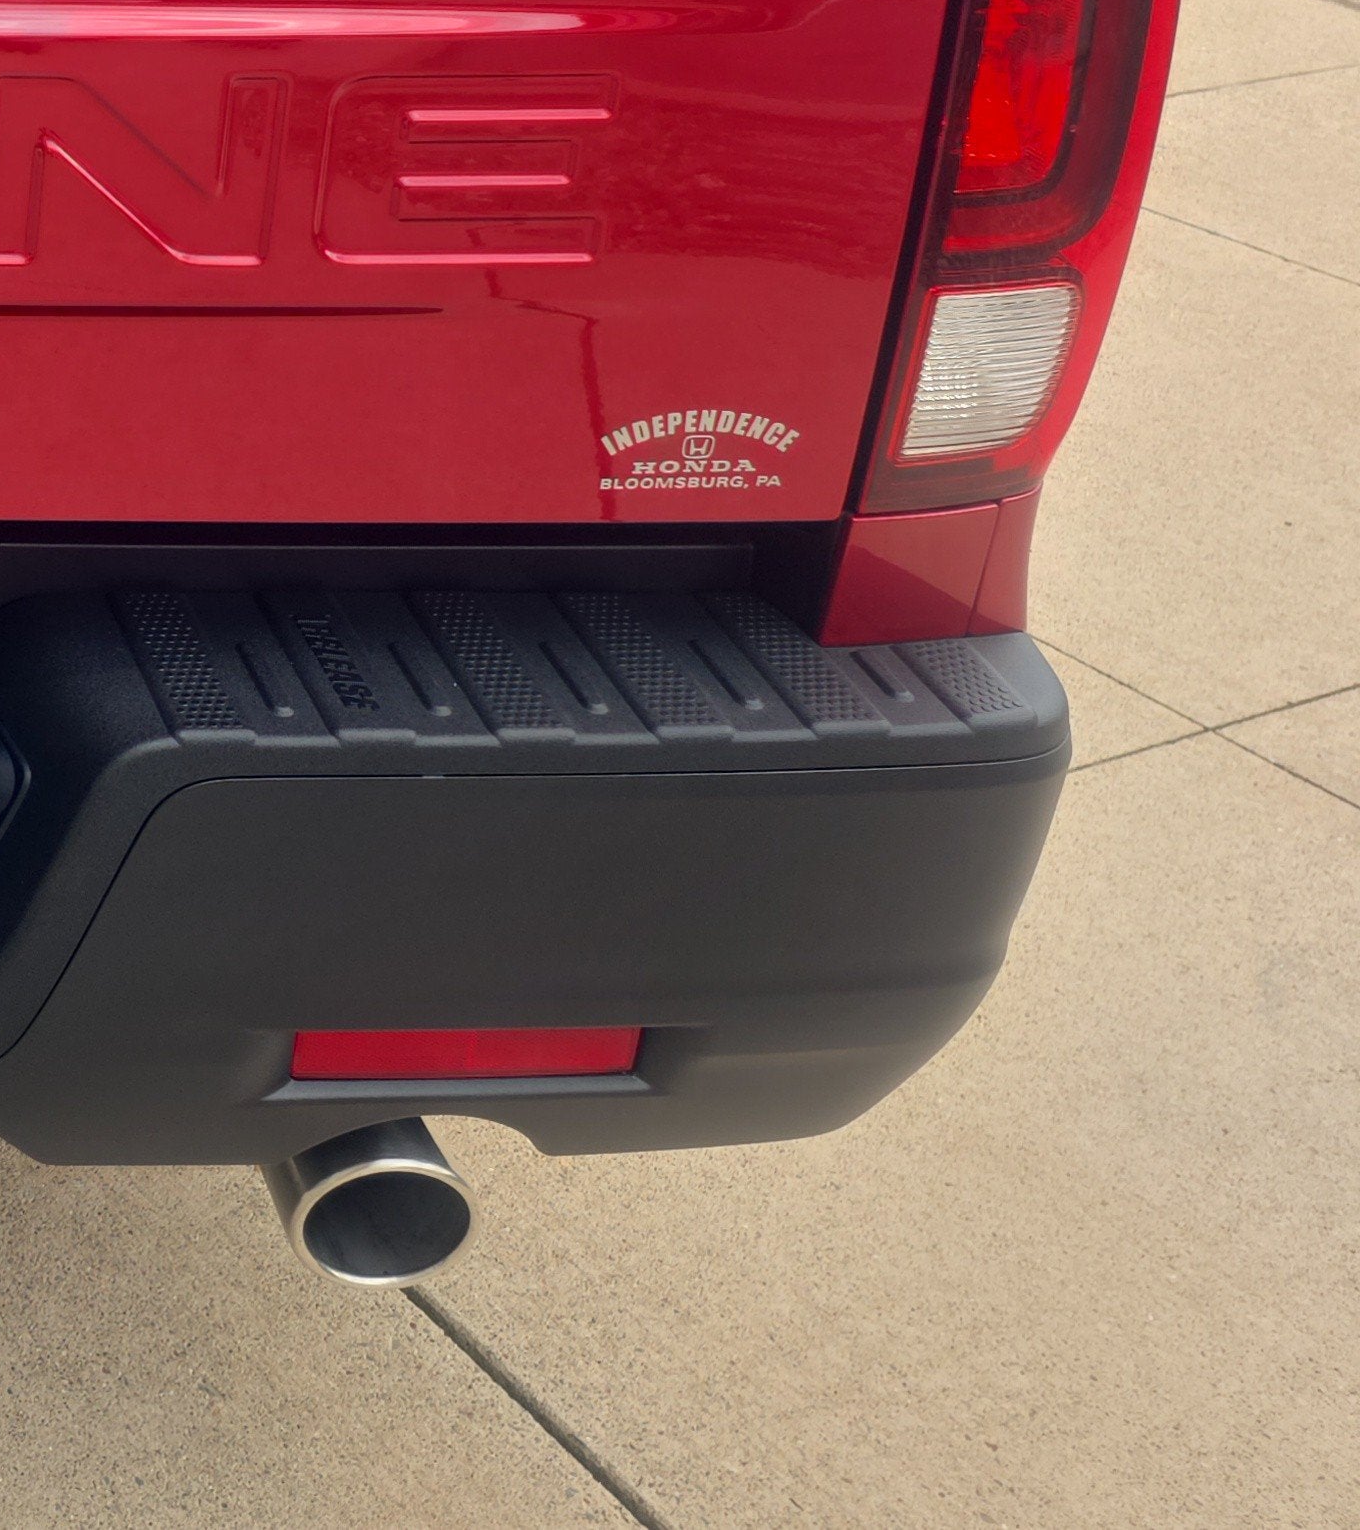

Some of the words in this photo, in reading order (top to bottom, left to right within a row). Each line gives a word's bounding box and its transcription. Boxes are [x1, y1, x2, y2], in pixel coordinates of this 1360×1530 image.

[600, 409, 800, 456] INDEPENDENCE
[631, 459, 757, 475] HONDA
[599, 476, 749, 490] BLOOMSBURG,
[755, 475, 782, 488] PA
